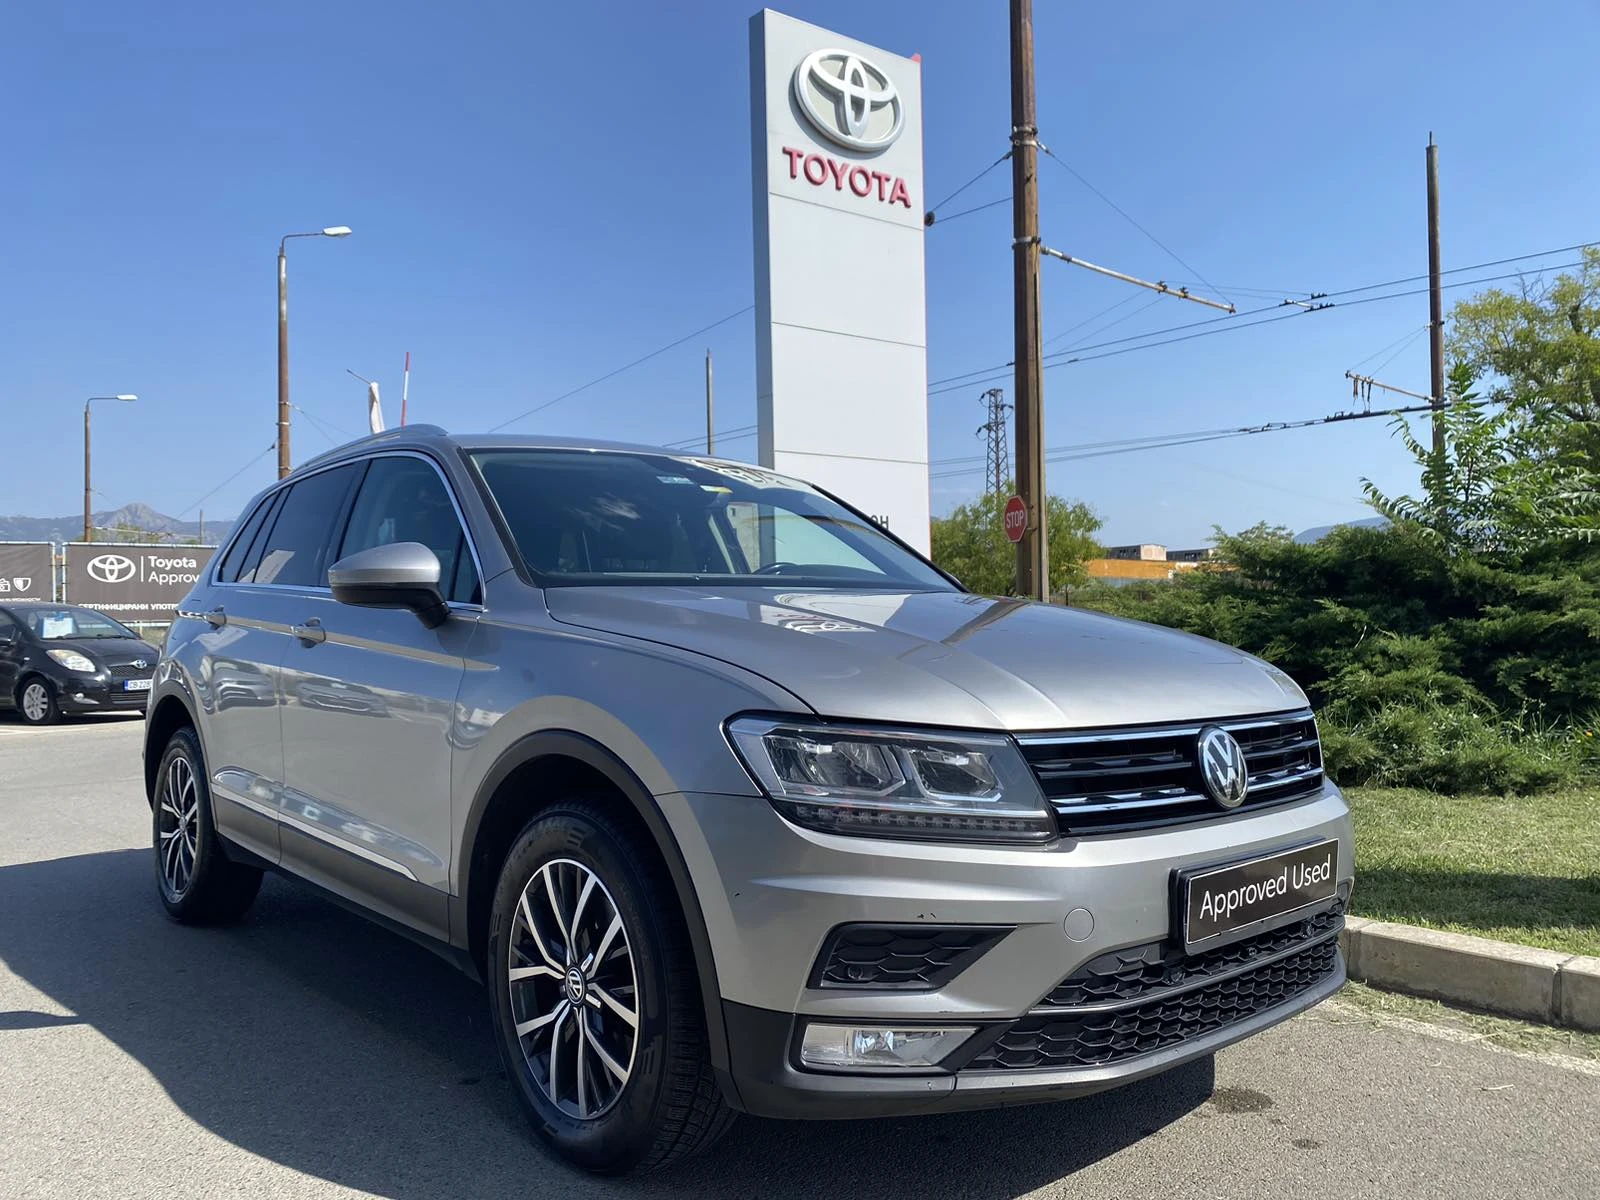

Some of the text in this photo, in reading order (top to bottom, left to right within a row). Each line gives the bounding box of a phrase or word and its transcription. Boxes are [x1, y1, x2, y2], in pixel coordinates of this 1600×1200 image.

[782, 146, 911, 208] TOYOTA
[1005, 510, 1024, 528] STOP
[148, 555, 197, 570] Toyota
[1199, 853, 1331, 922] Approved Used
